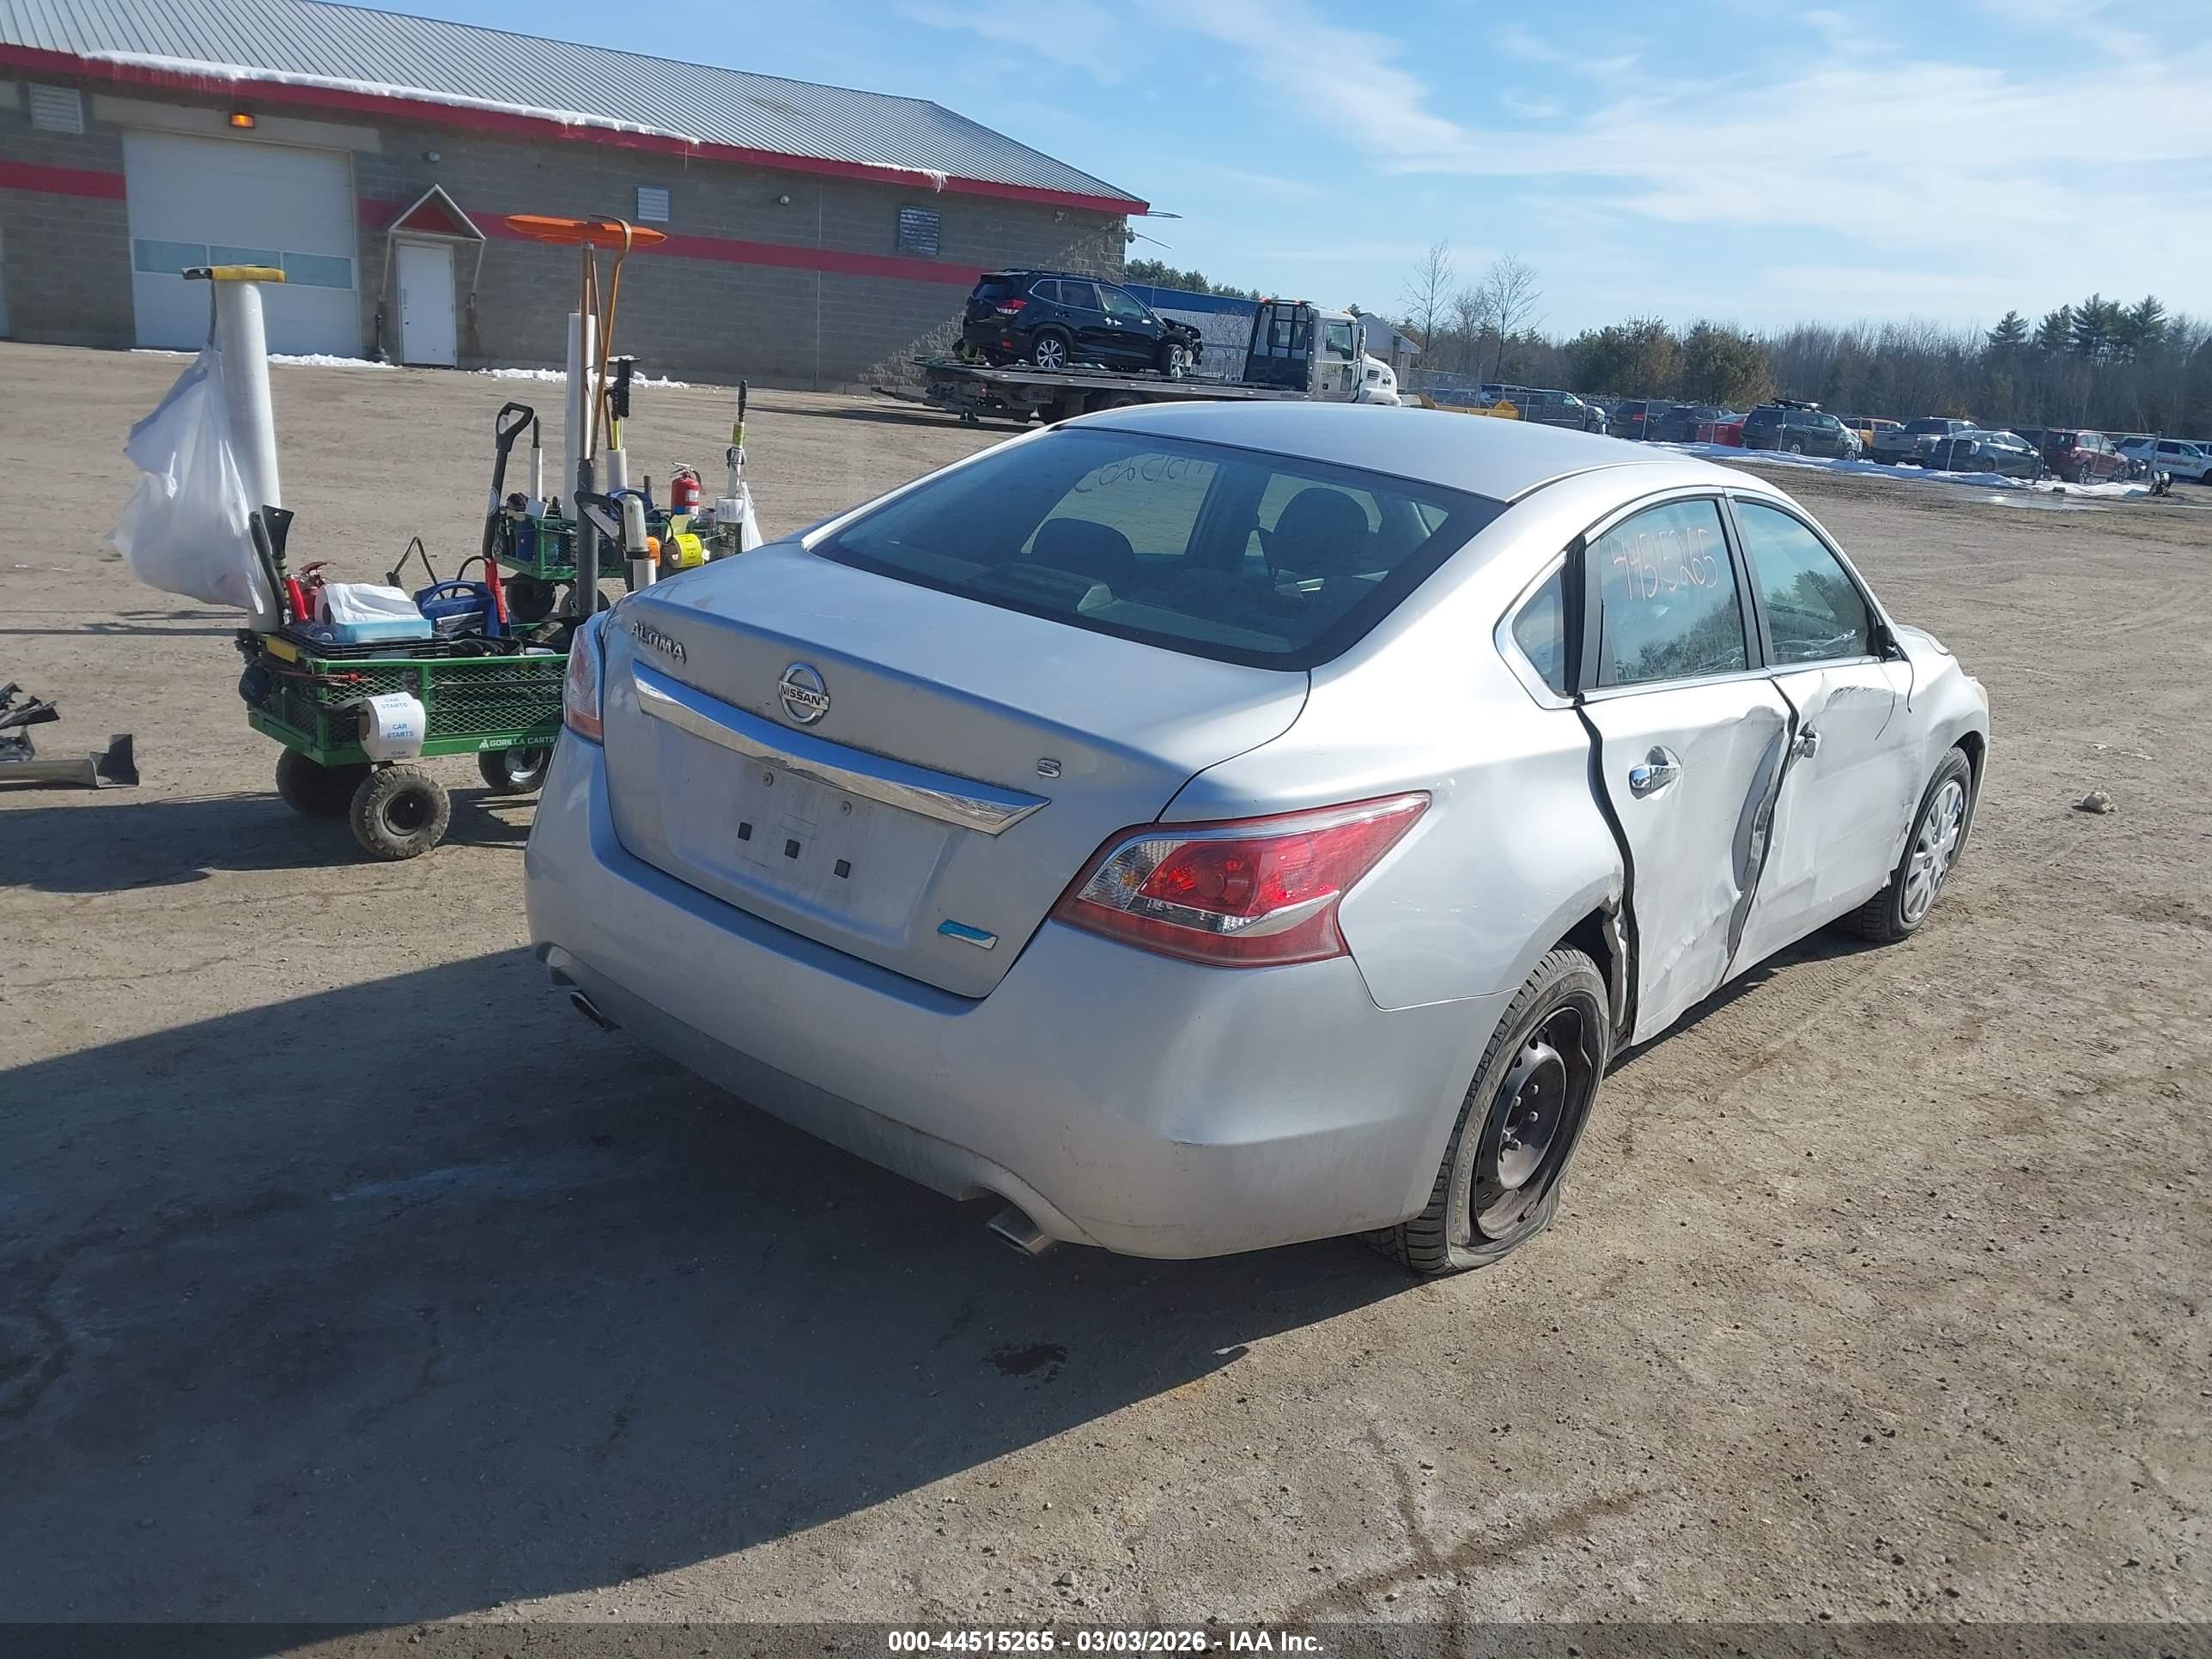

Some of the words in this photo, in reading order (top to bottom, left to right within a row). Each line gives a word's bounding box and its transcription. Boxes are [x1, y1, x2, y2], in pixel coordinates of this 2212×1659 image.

[1608, 527, 1718, 602] 44515265
[781, 684, 821, 706] NISSAN
[489, 738, 526, 747] GORILLA
[527, 736, 556, 744] CARTS
[1037, 757, 1060, 779] S
